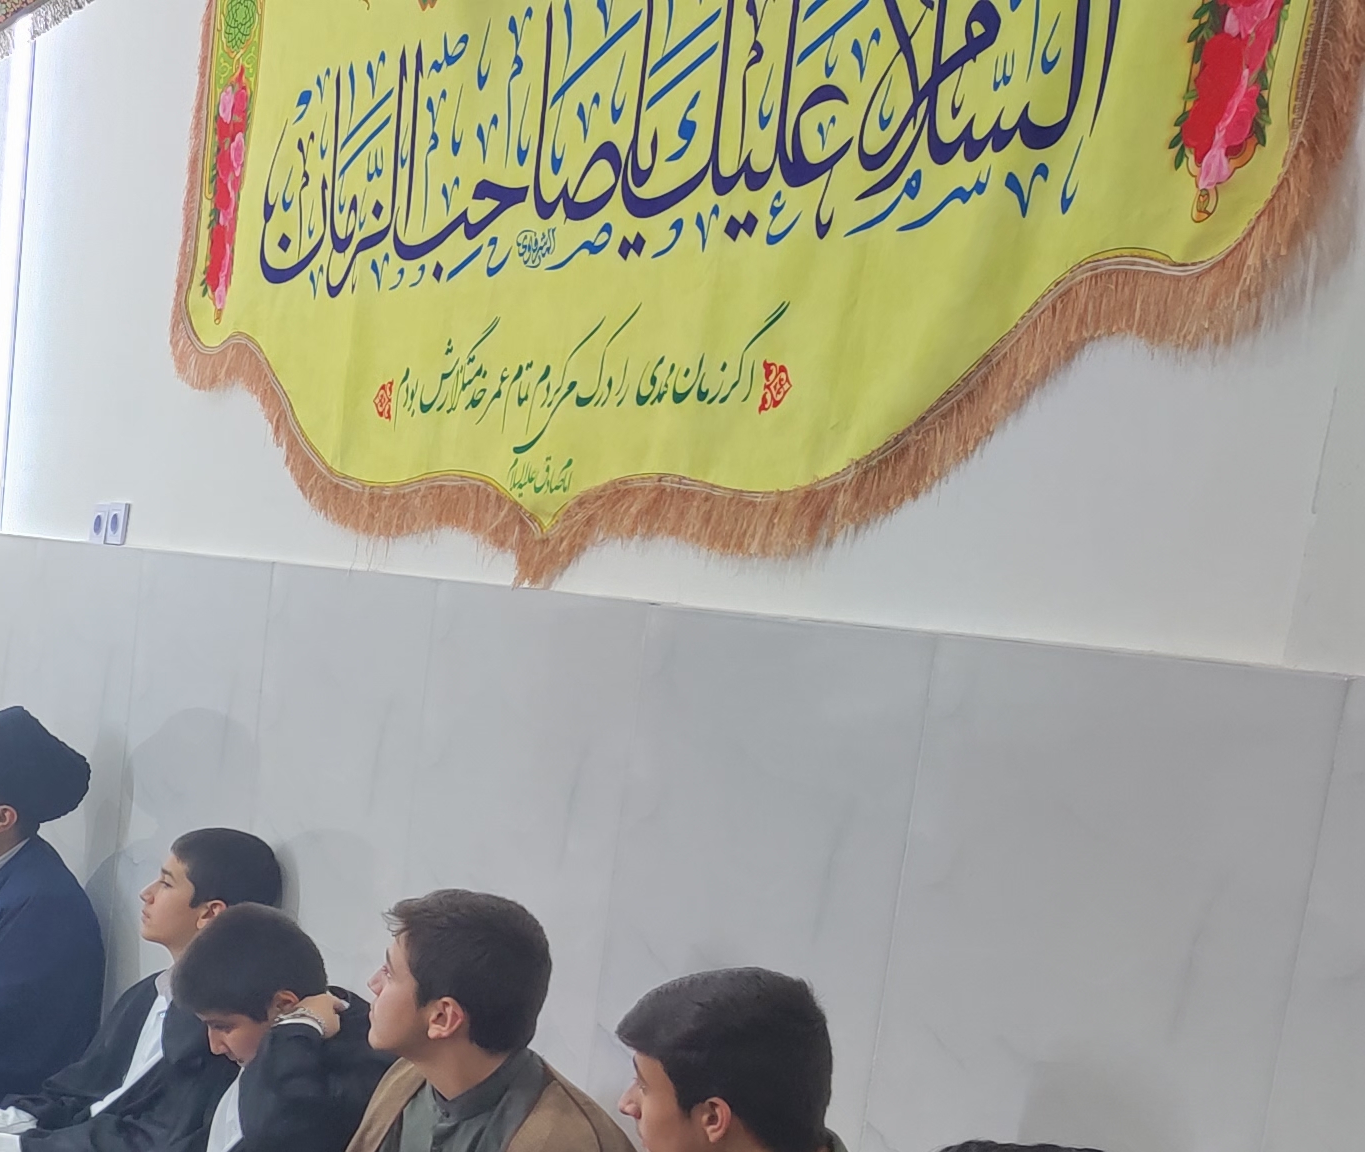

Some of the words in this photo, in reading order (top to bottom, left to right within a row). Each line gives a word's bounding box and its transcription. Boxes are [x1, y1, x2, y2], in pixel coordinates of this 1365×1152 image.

[576, 302, 642, 407] درک
[615, 357, 629, 407] را
[636, 355, 675, 406] مهدی
[672, 353, 727, 405] زمان
[719, 301, 790, 404] اگر
[394, 367, 418, 432] بودم
[475, 367, 509, 425] عمر
[502, 360, 533, 434] تمام
